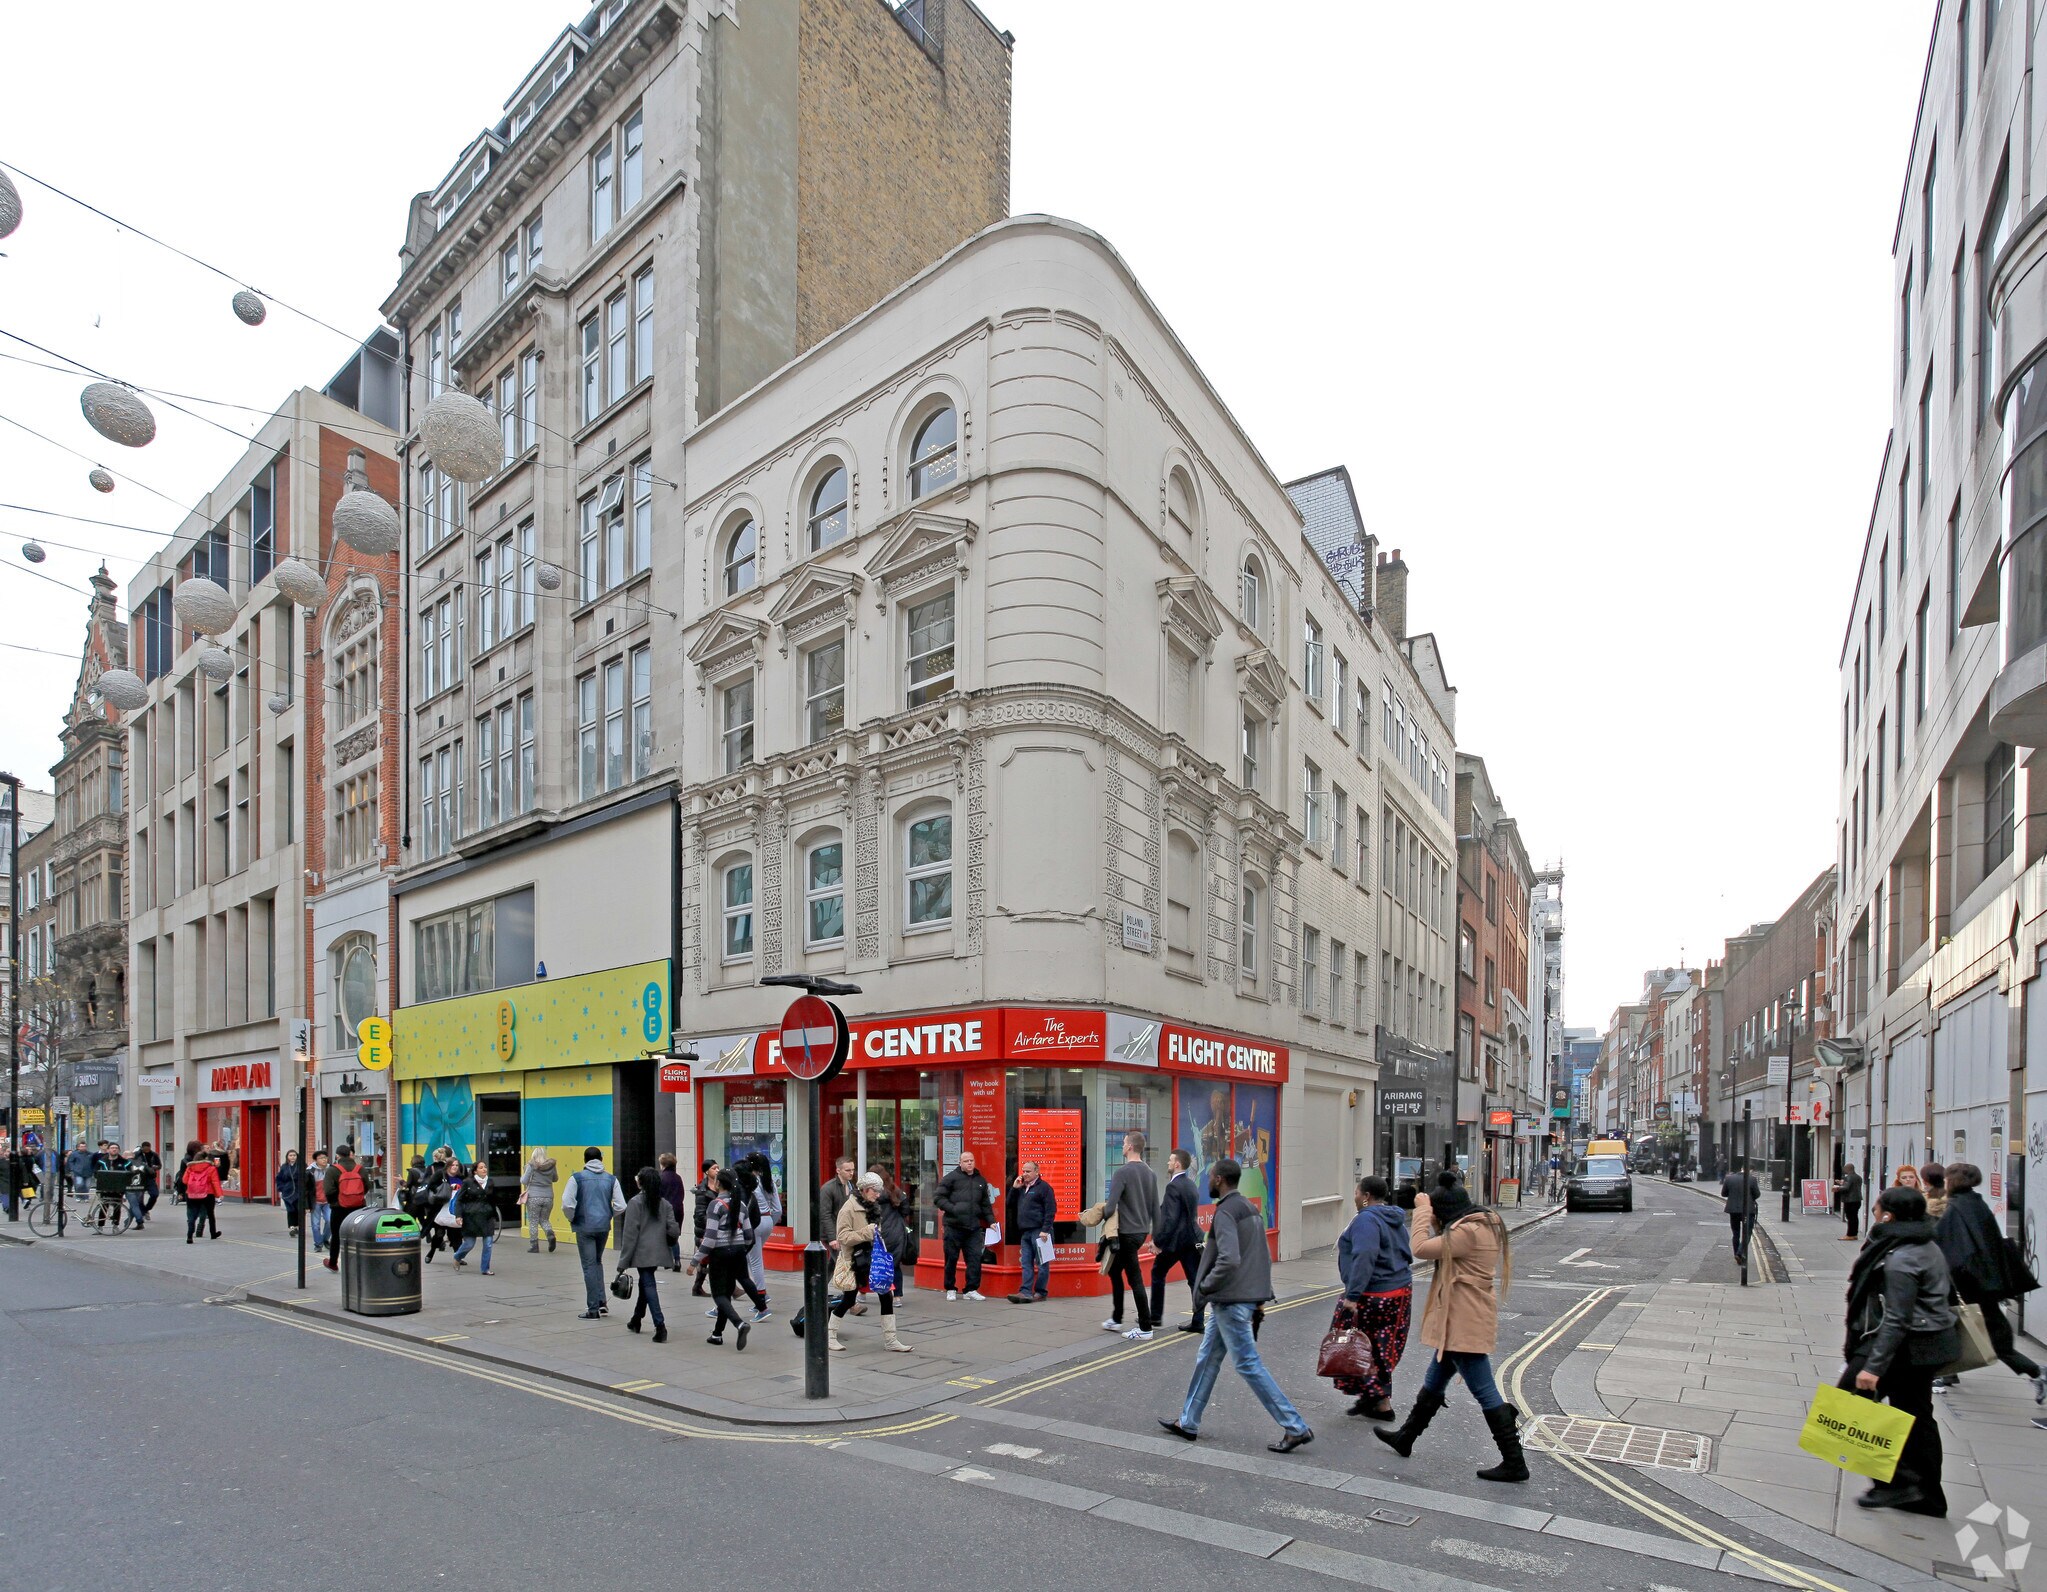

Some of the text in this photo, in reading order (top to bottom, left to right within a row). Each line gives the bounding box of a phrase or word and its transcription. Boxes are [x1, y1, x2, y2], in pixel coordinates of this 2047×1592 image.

[1126, 914, 1144, 928] POLAND
[1126, 926, 1142, 939] STREET
[1044, 1017, 1064, 1031] The
[864, 1020, 983, 1059] CENTRE
[1014, 1031, 1099, 1050] Airfare Experts
[1168, 1033, 1276, 1075] FLIGHT CENTRE
[211, 1062, 271, 1092] MATALAN
[1384, 1092, 1423, 1100] ARIRANG
[1384, 1103, 1422, 1114] 아리랑
[1816, 1413, 1893, 1450] SHOP ONLINE
